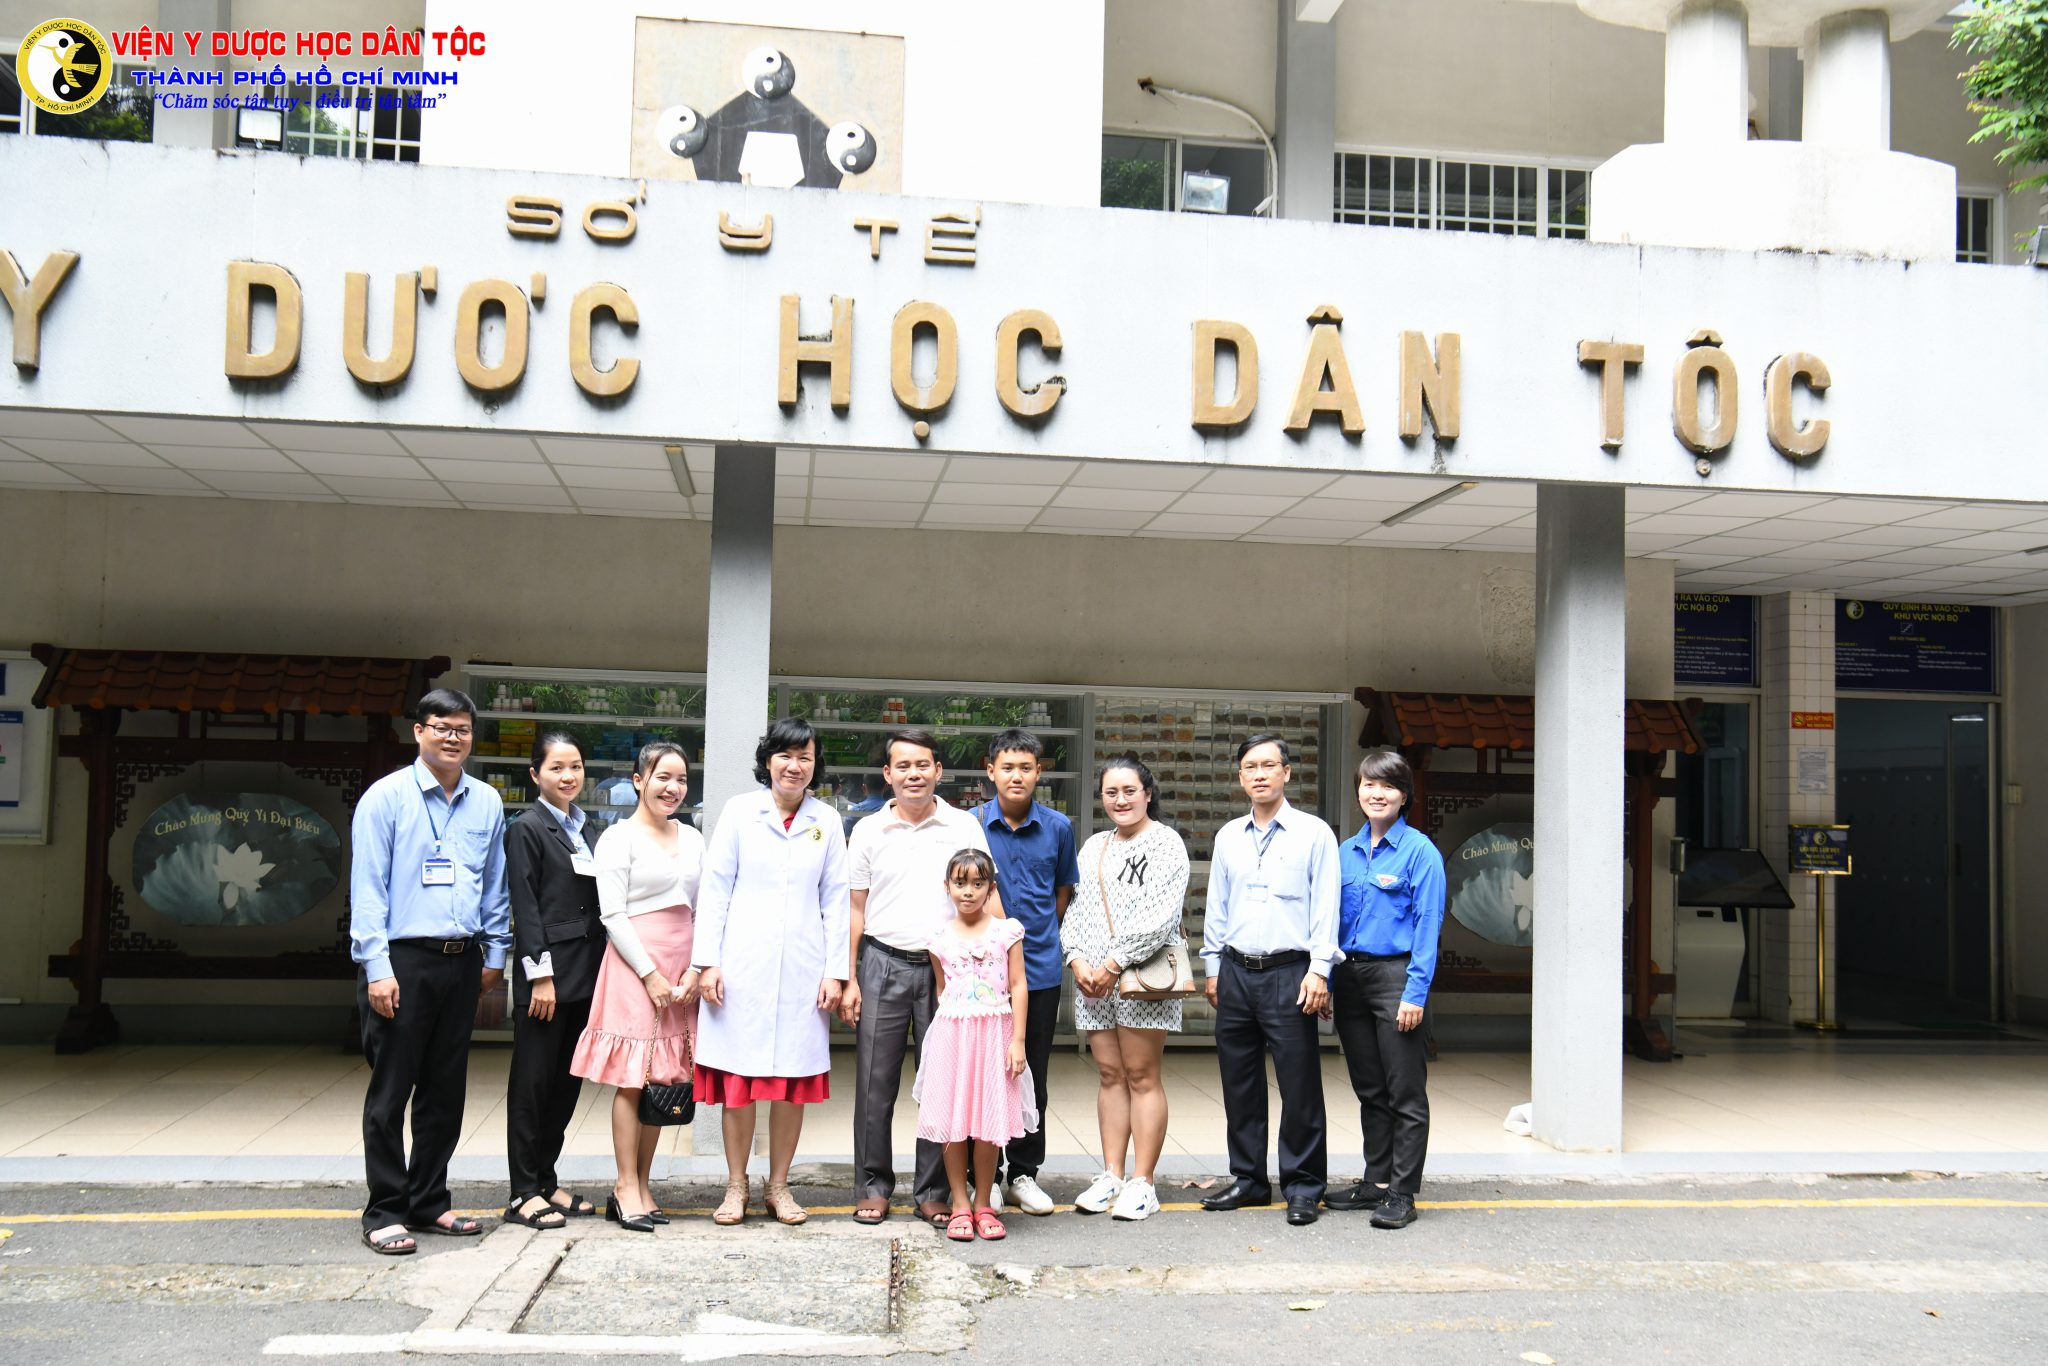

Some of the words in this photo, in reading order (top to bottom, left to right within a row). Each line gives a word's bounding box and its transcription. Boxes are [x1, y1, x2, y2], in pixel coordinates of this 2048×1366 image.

[719, 210, 774, 251] Y
[853, 206, 982, 266] TẾ
[0, 249, 81, 371] Y
[777, 294, 1067, 442] HỌC
[1191, 305, 1462, 441] DÂN
[1577, 329, 1832, 477] TỘC
